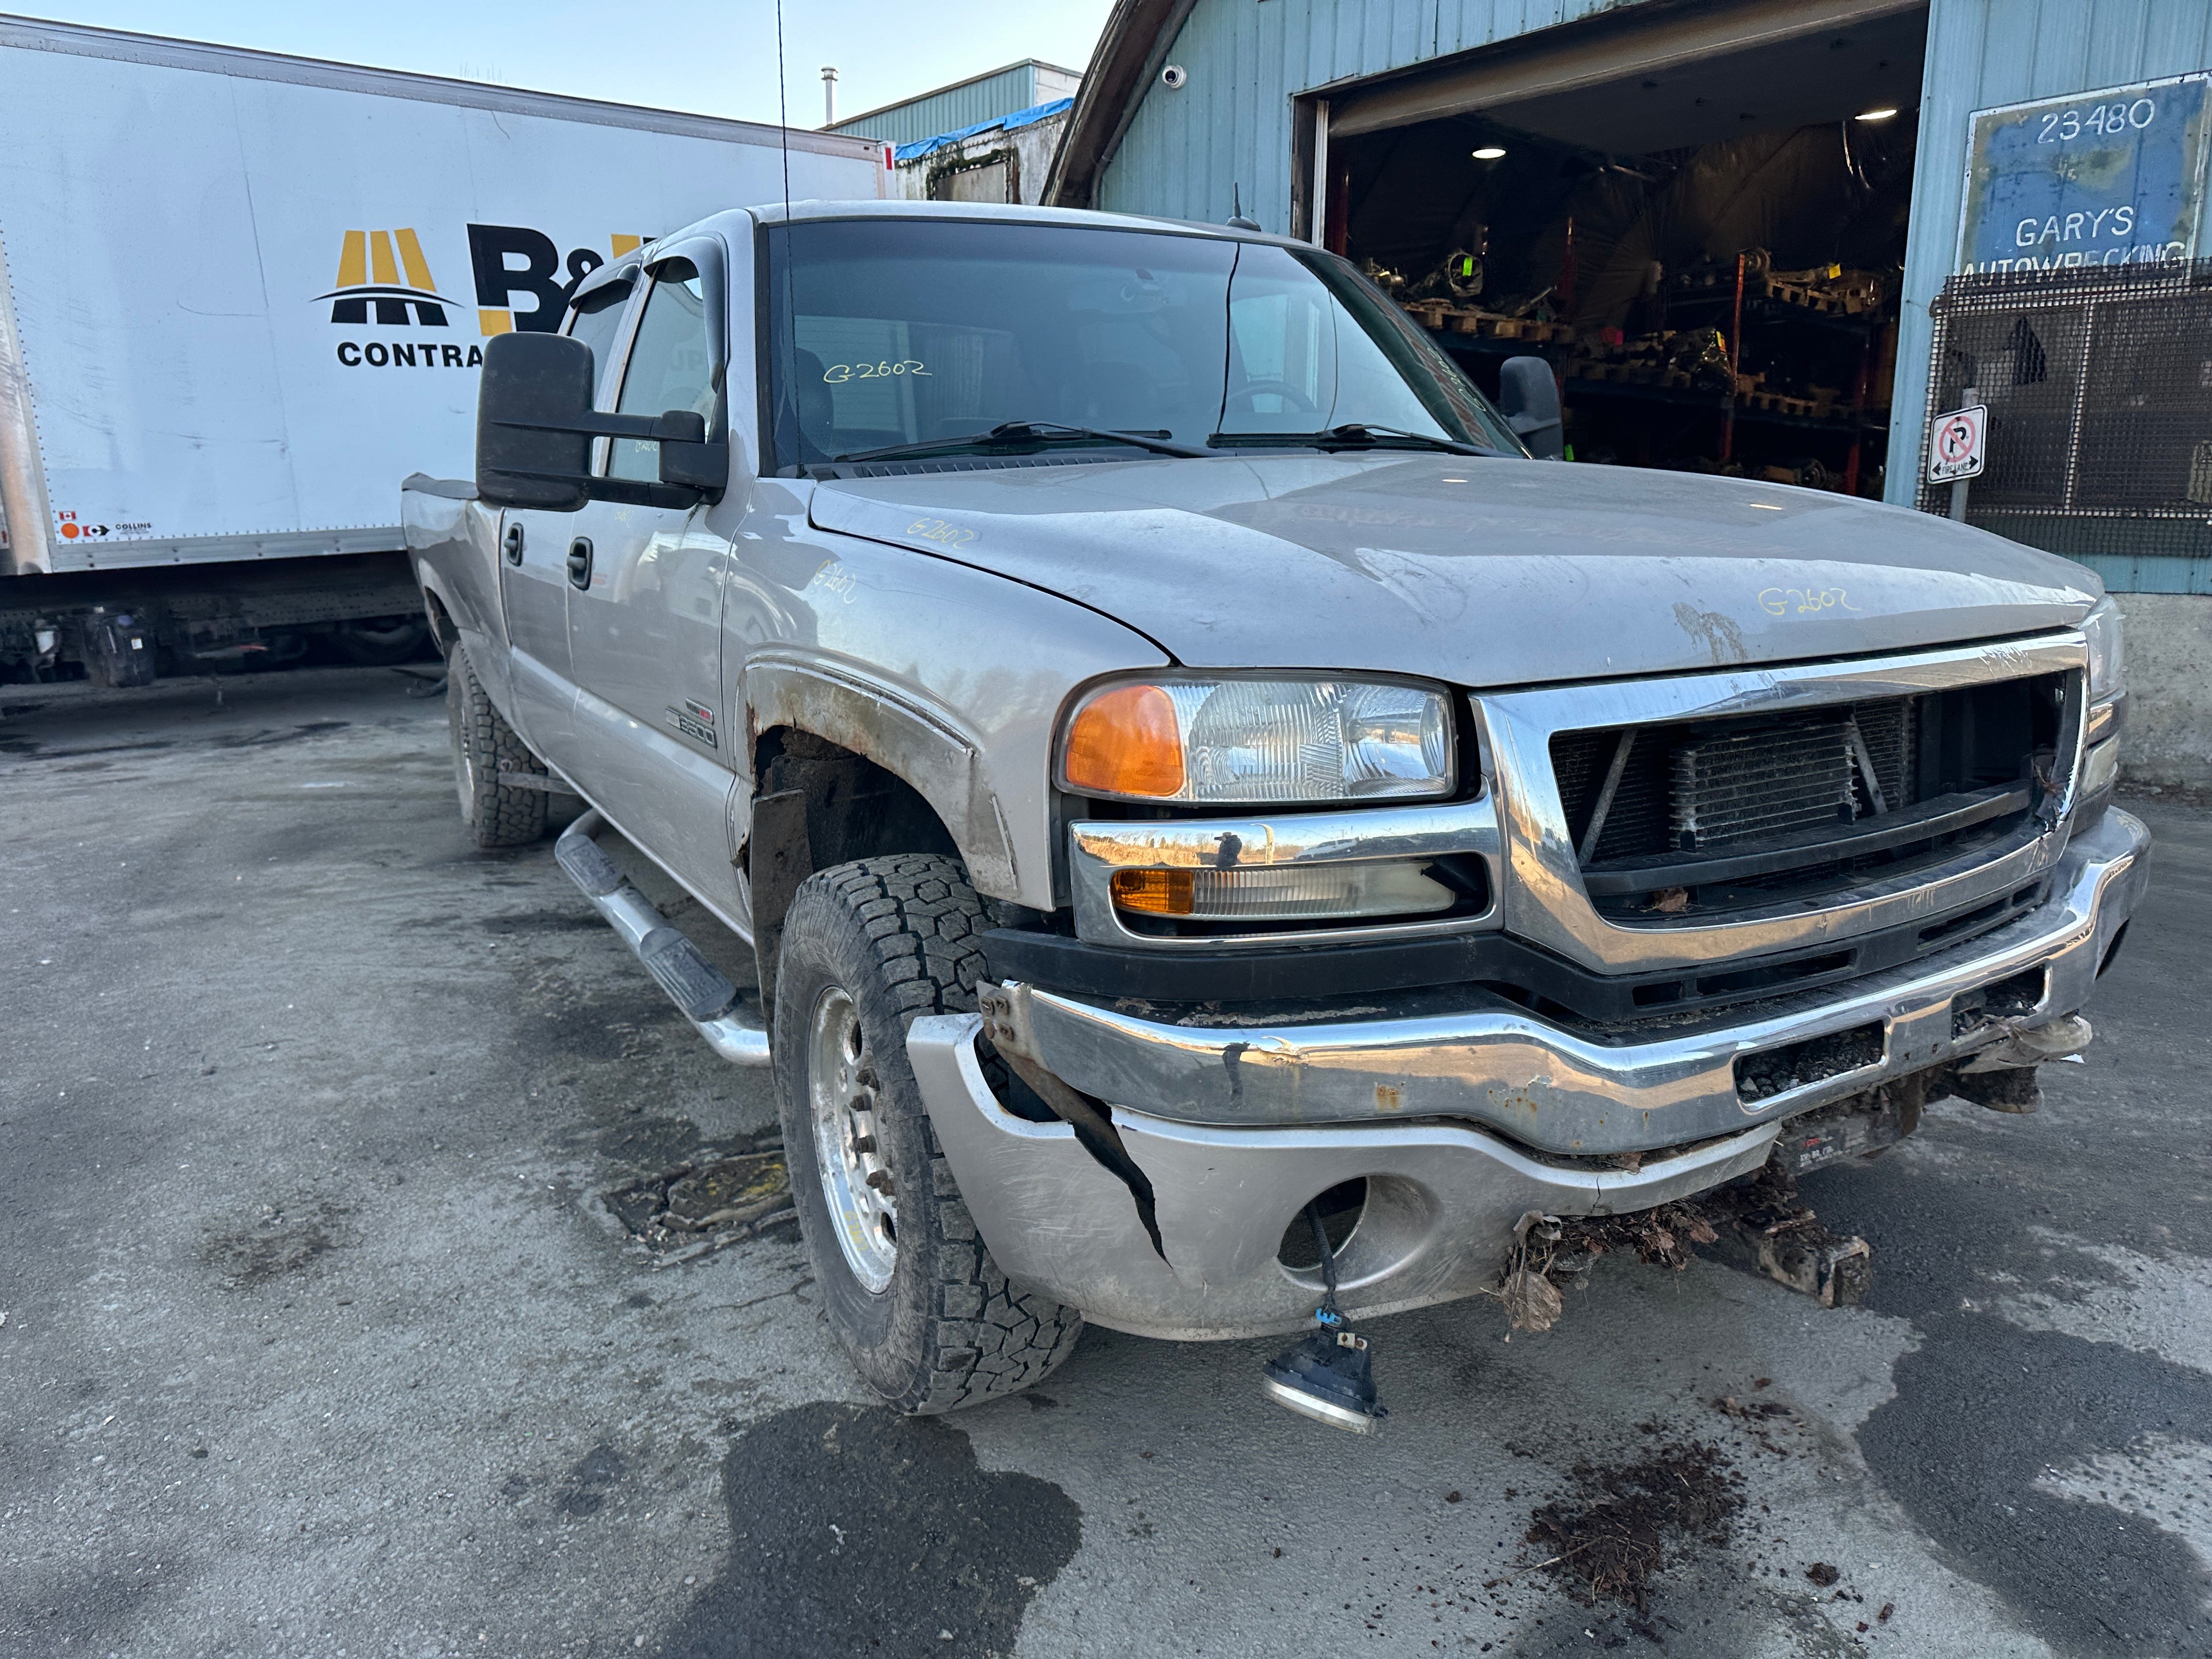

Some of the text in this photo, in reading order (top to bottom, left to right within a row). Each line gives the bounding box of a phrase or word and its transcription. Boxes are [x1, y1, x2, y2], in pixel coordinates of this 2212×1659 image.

[2037, 99, 2156, 143] 23480
[2016, 206, 2134, 247] GARY'S
[823, 361, 932, 383] G2602
[1942, 465, 1953, 475] FIRE
[907, 518, 974, 548] G2602
[1758, 587, 1862, 615] G2602
[679, 714, 715, 748] 3500
